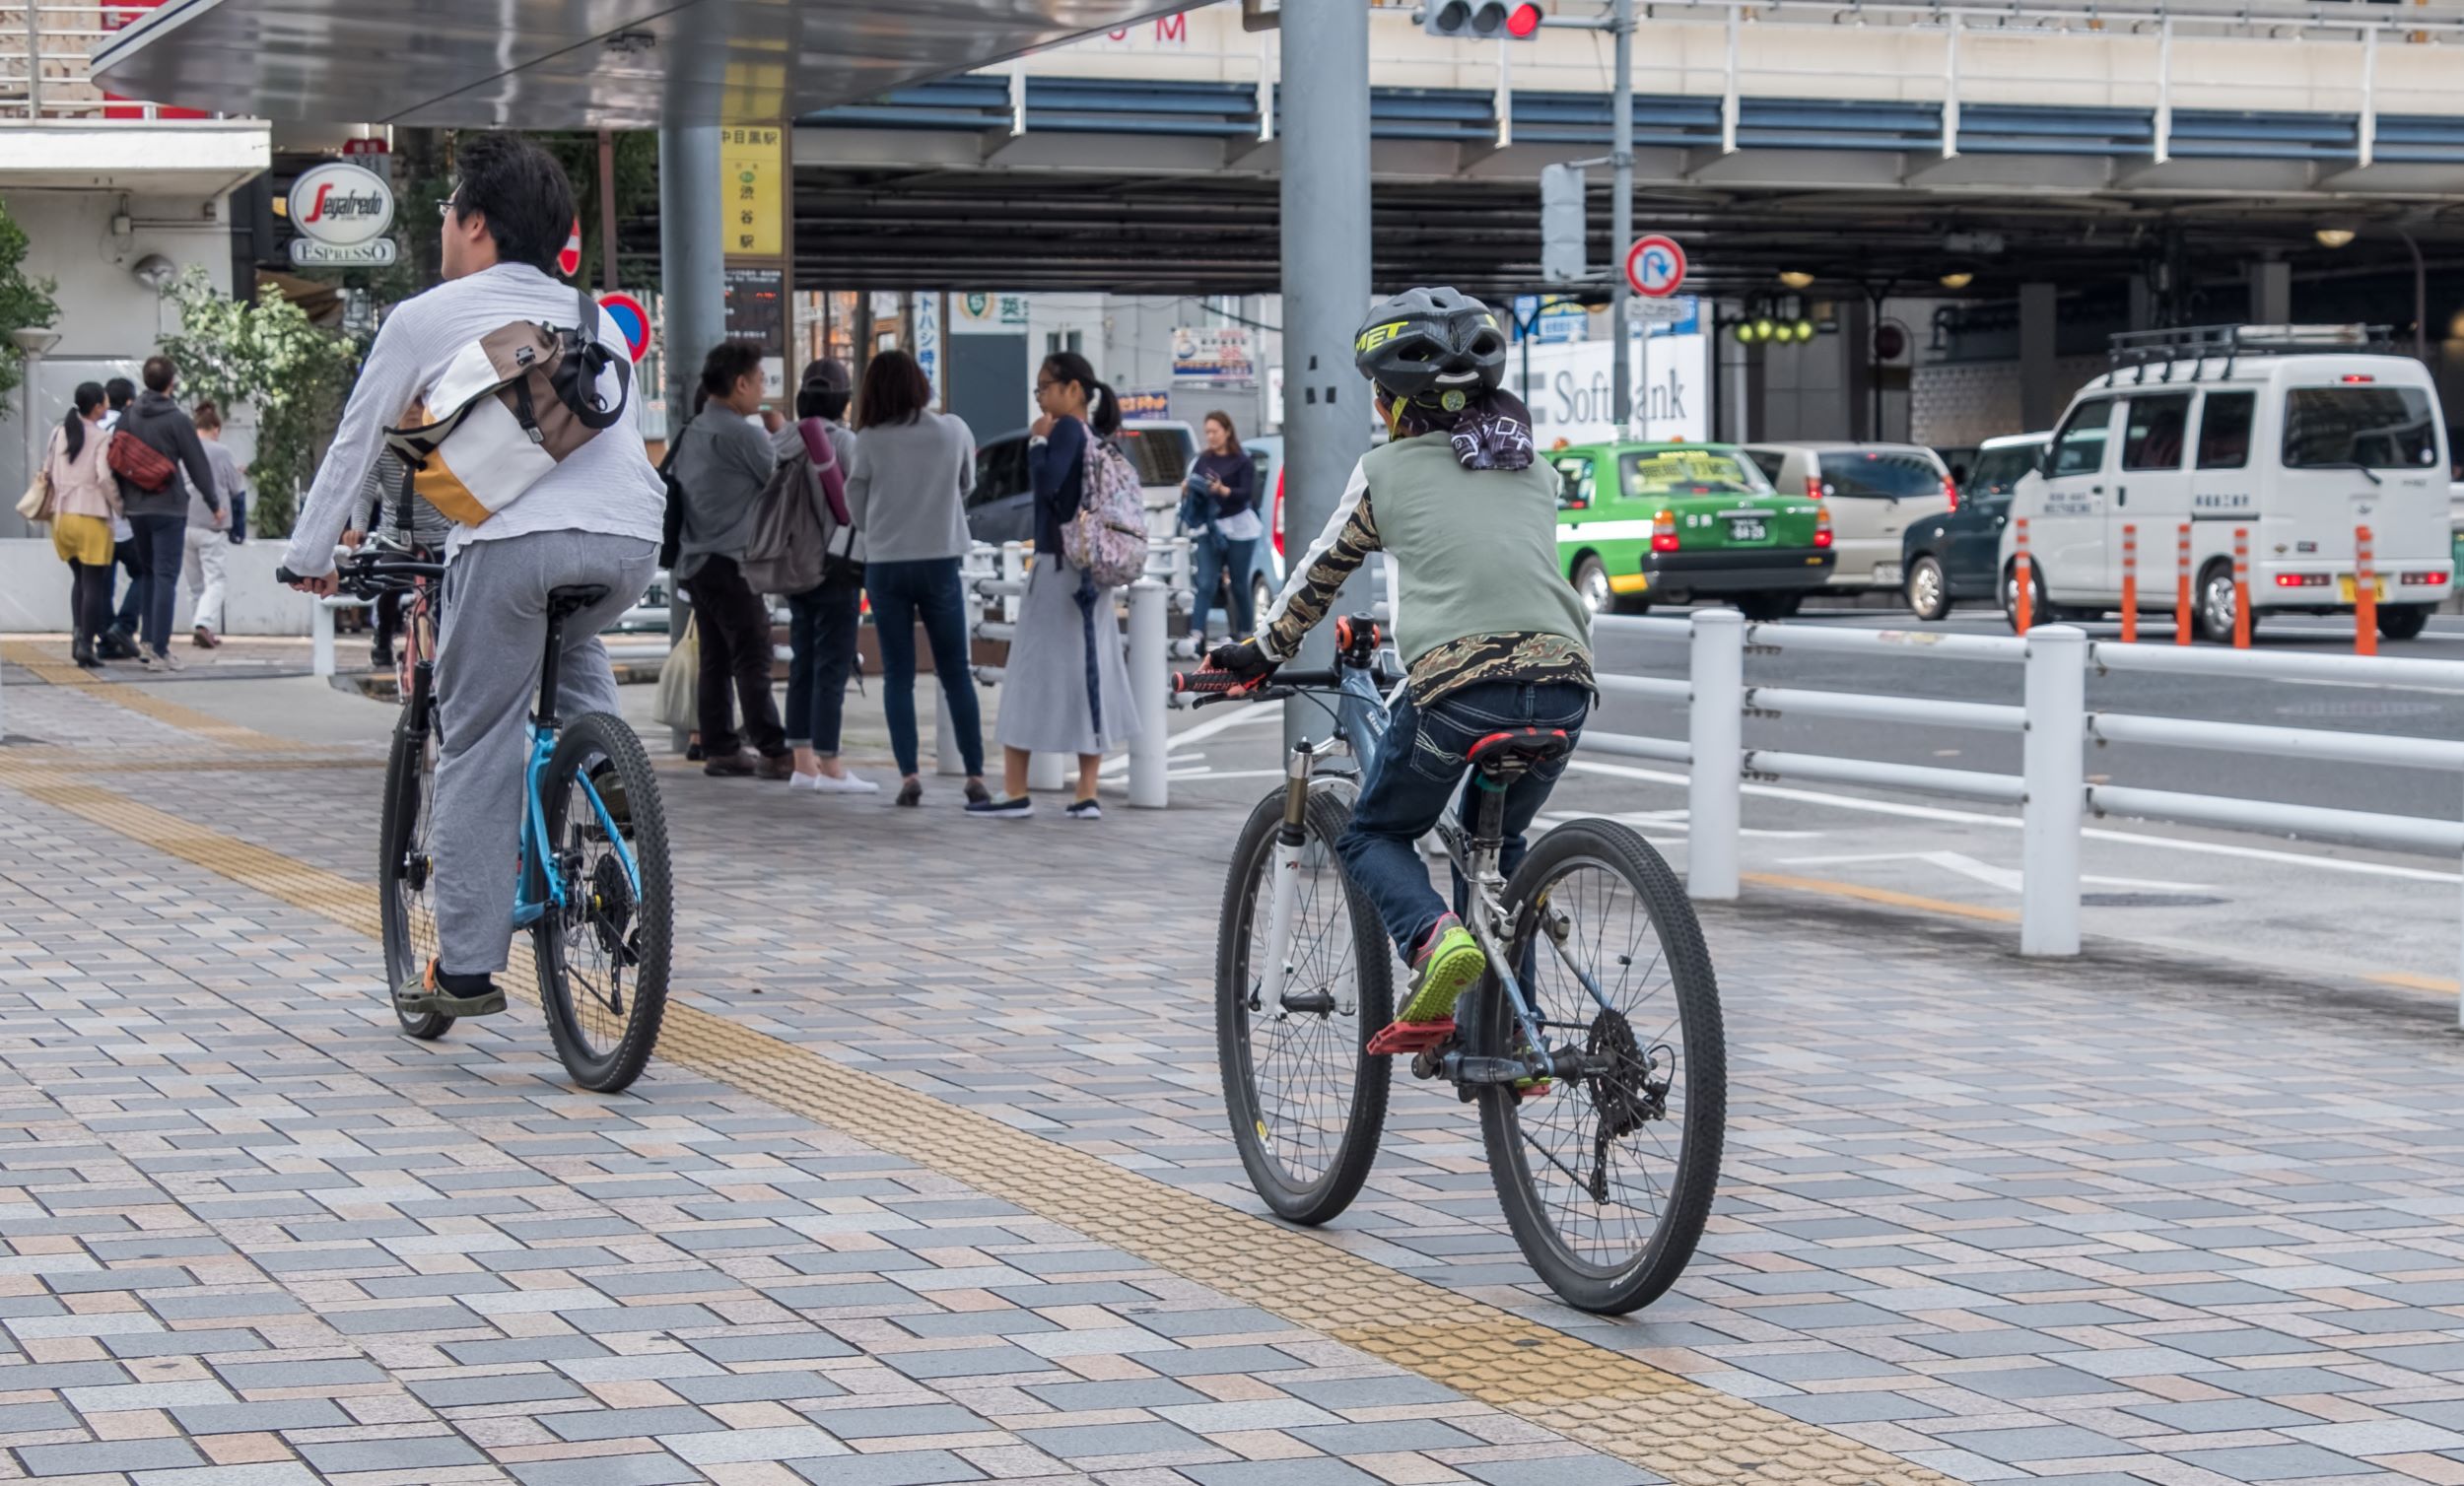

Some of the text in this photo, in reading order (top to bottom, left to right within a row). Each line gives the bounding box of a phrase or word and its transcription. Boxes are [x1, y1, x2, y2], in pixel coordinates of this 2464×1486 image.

[304, 183, 382, 223] Segafredo
[1355, 320, 1409, 353] MET
[1554, 369, 1687, 425] Softank
